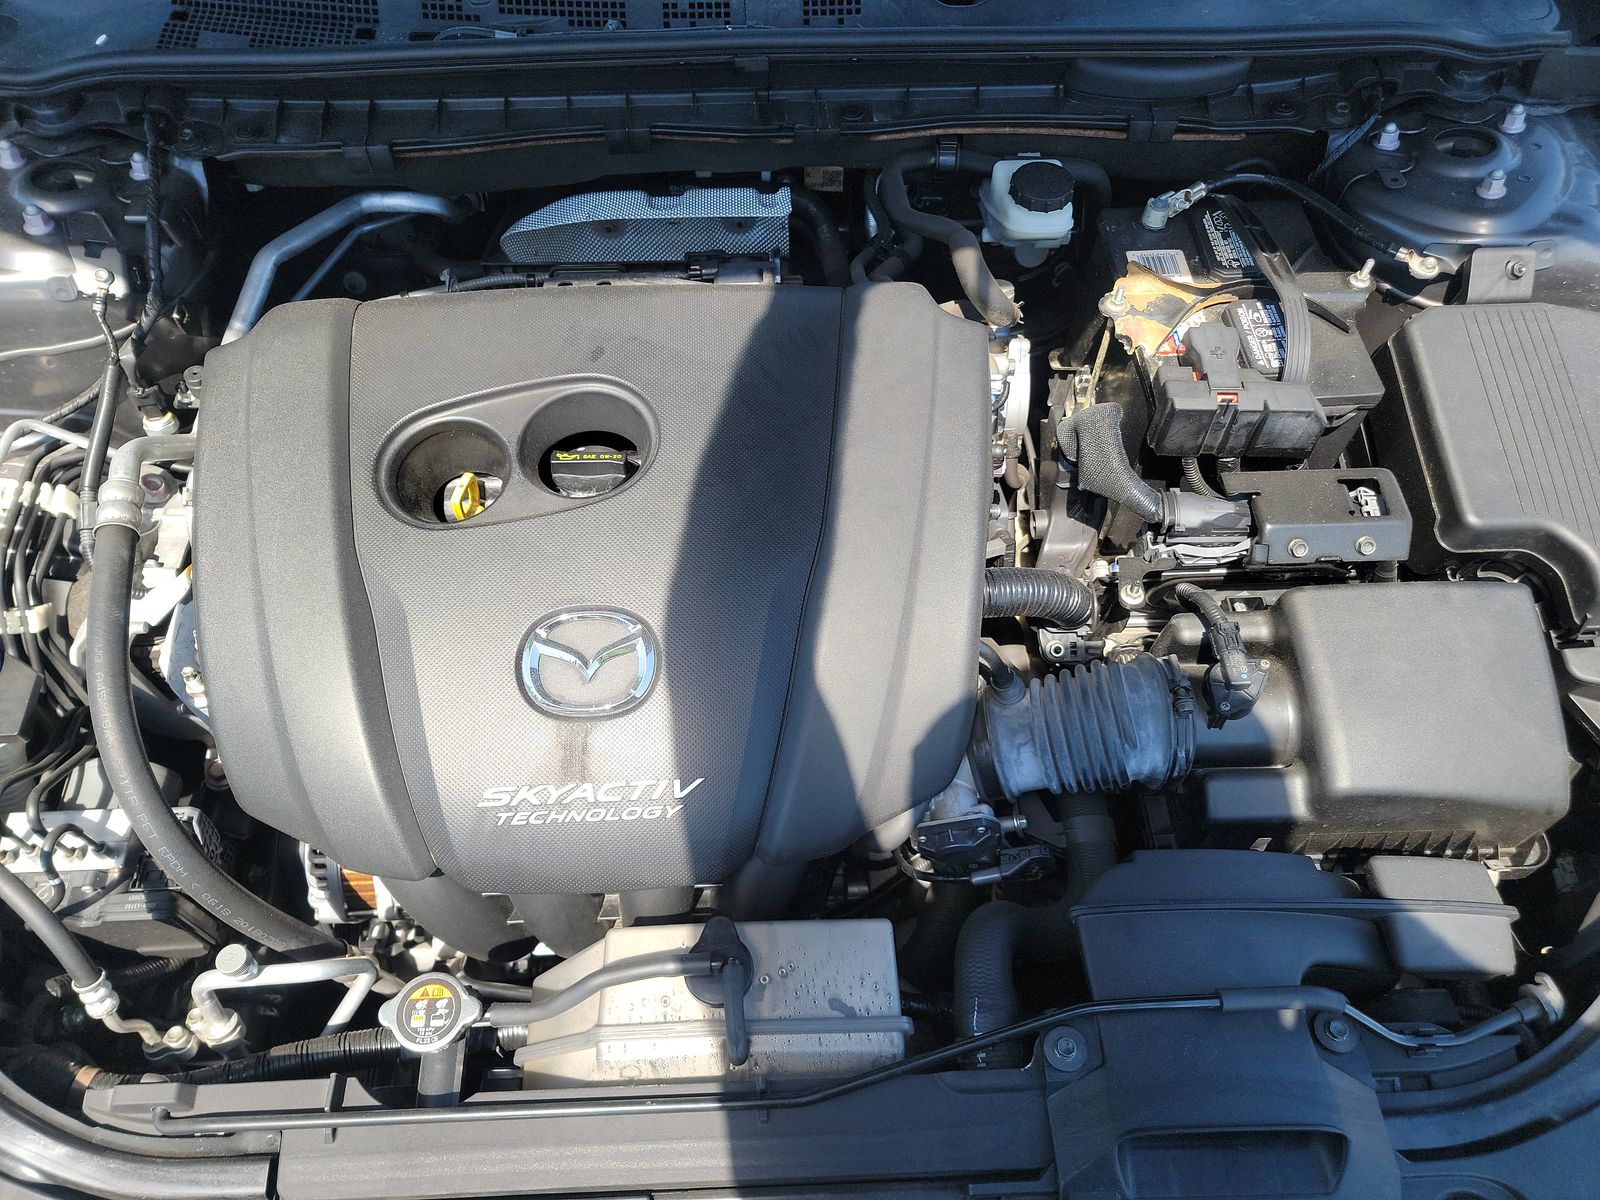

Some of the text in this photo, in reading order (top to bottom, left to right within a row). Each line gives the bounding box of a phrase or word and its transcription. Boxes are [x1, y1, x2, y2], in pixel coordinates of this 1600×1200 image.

[1237, 307, 1251, 330] POISON
[1247, 335, 1262, 359] DANGER
[476, 778, 706, 807] SKYACTIV
[496, 804, 685, 826] TECHNOLOGY
